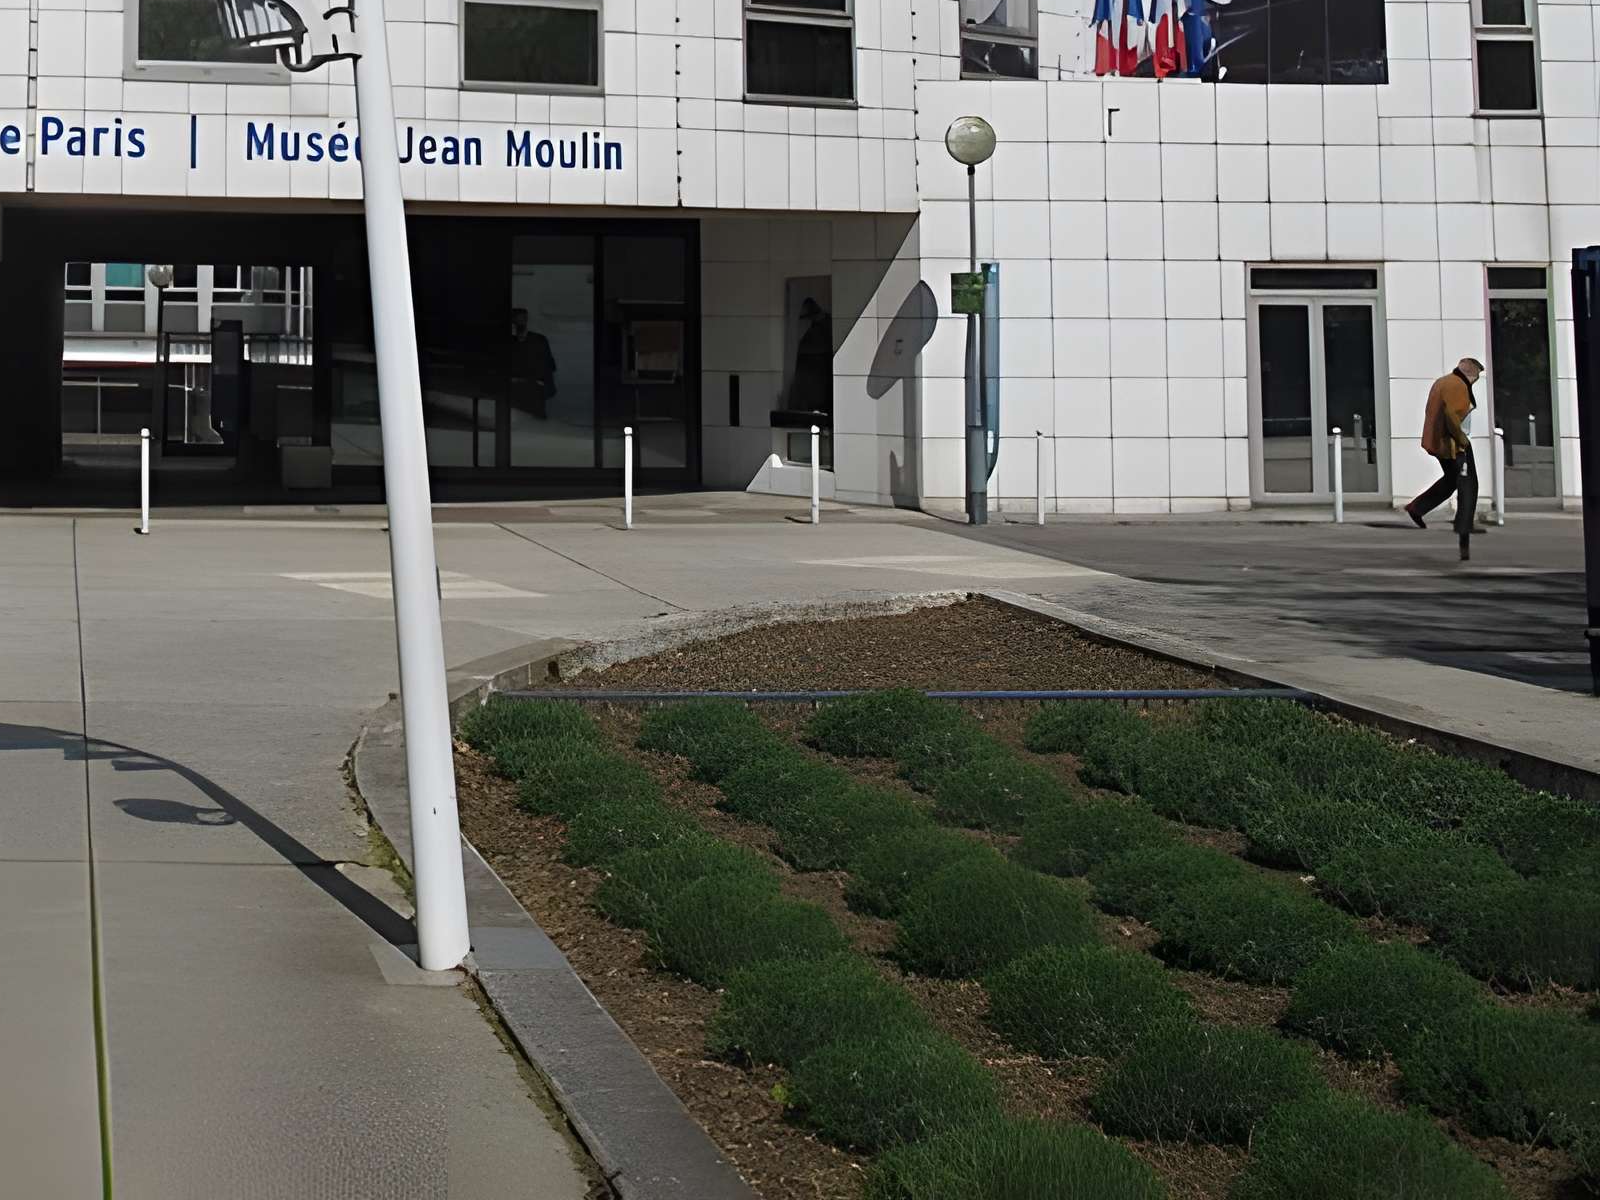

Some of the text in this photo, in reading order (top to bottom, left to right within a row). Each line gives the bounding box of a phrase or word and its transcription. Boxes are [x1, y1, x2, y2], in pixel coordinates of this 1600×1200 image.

[41, 116, 146, 158] Paris
[246, 121, 362, 163] Musé
[399, 126, 483, 168] Jean
[505, 131, 624, 171] Moulin
